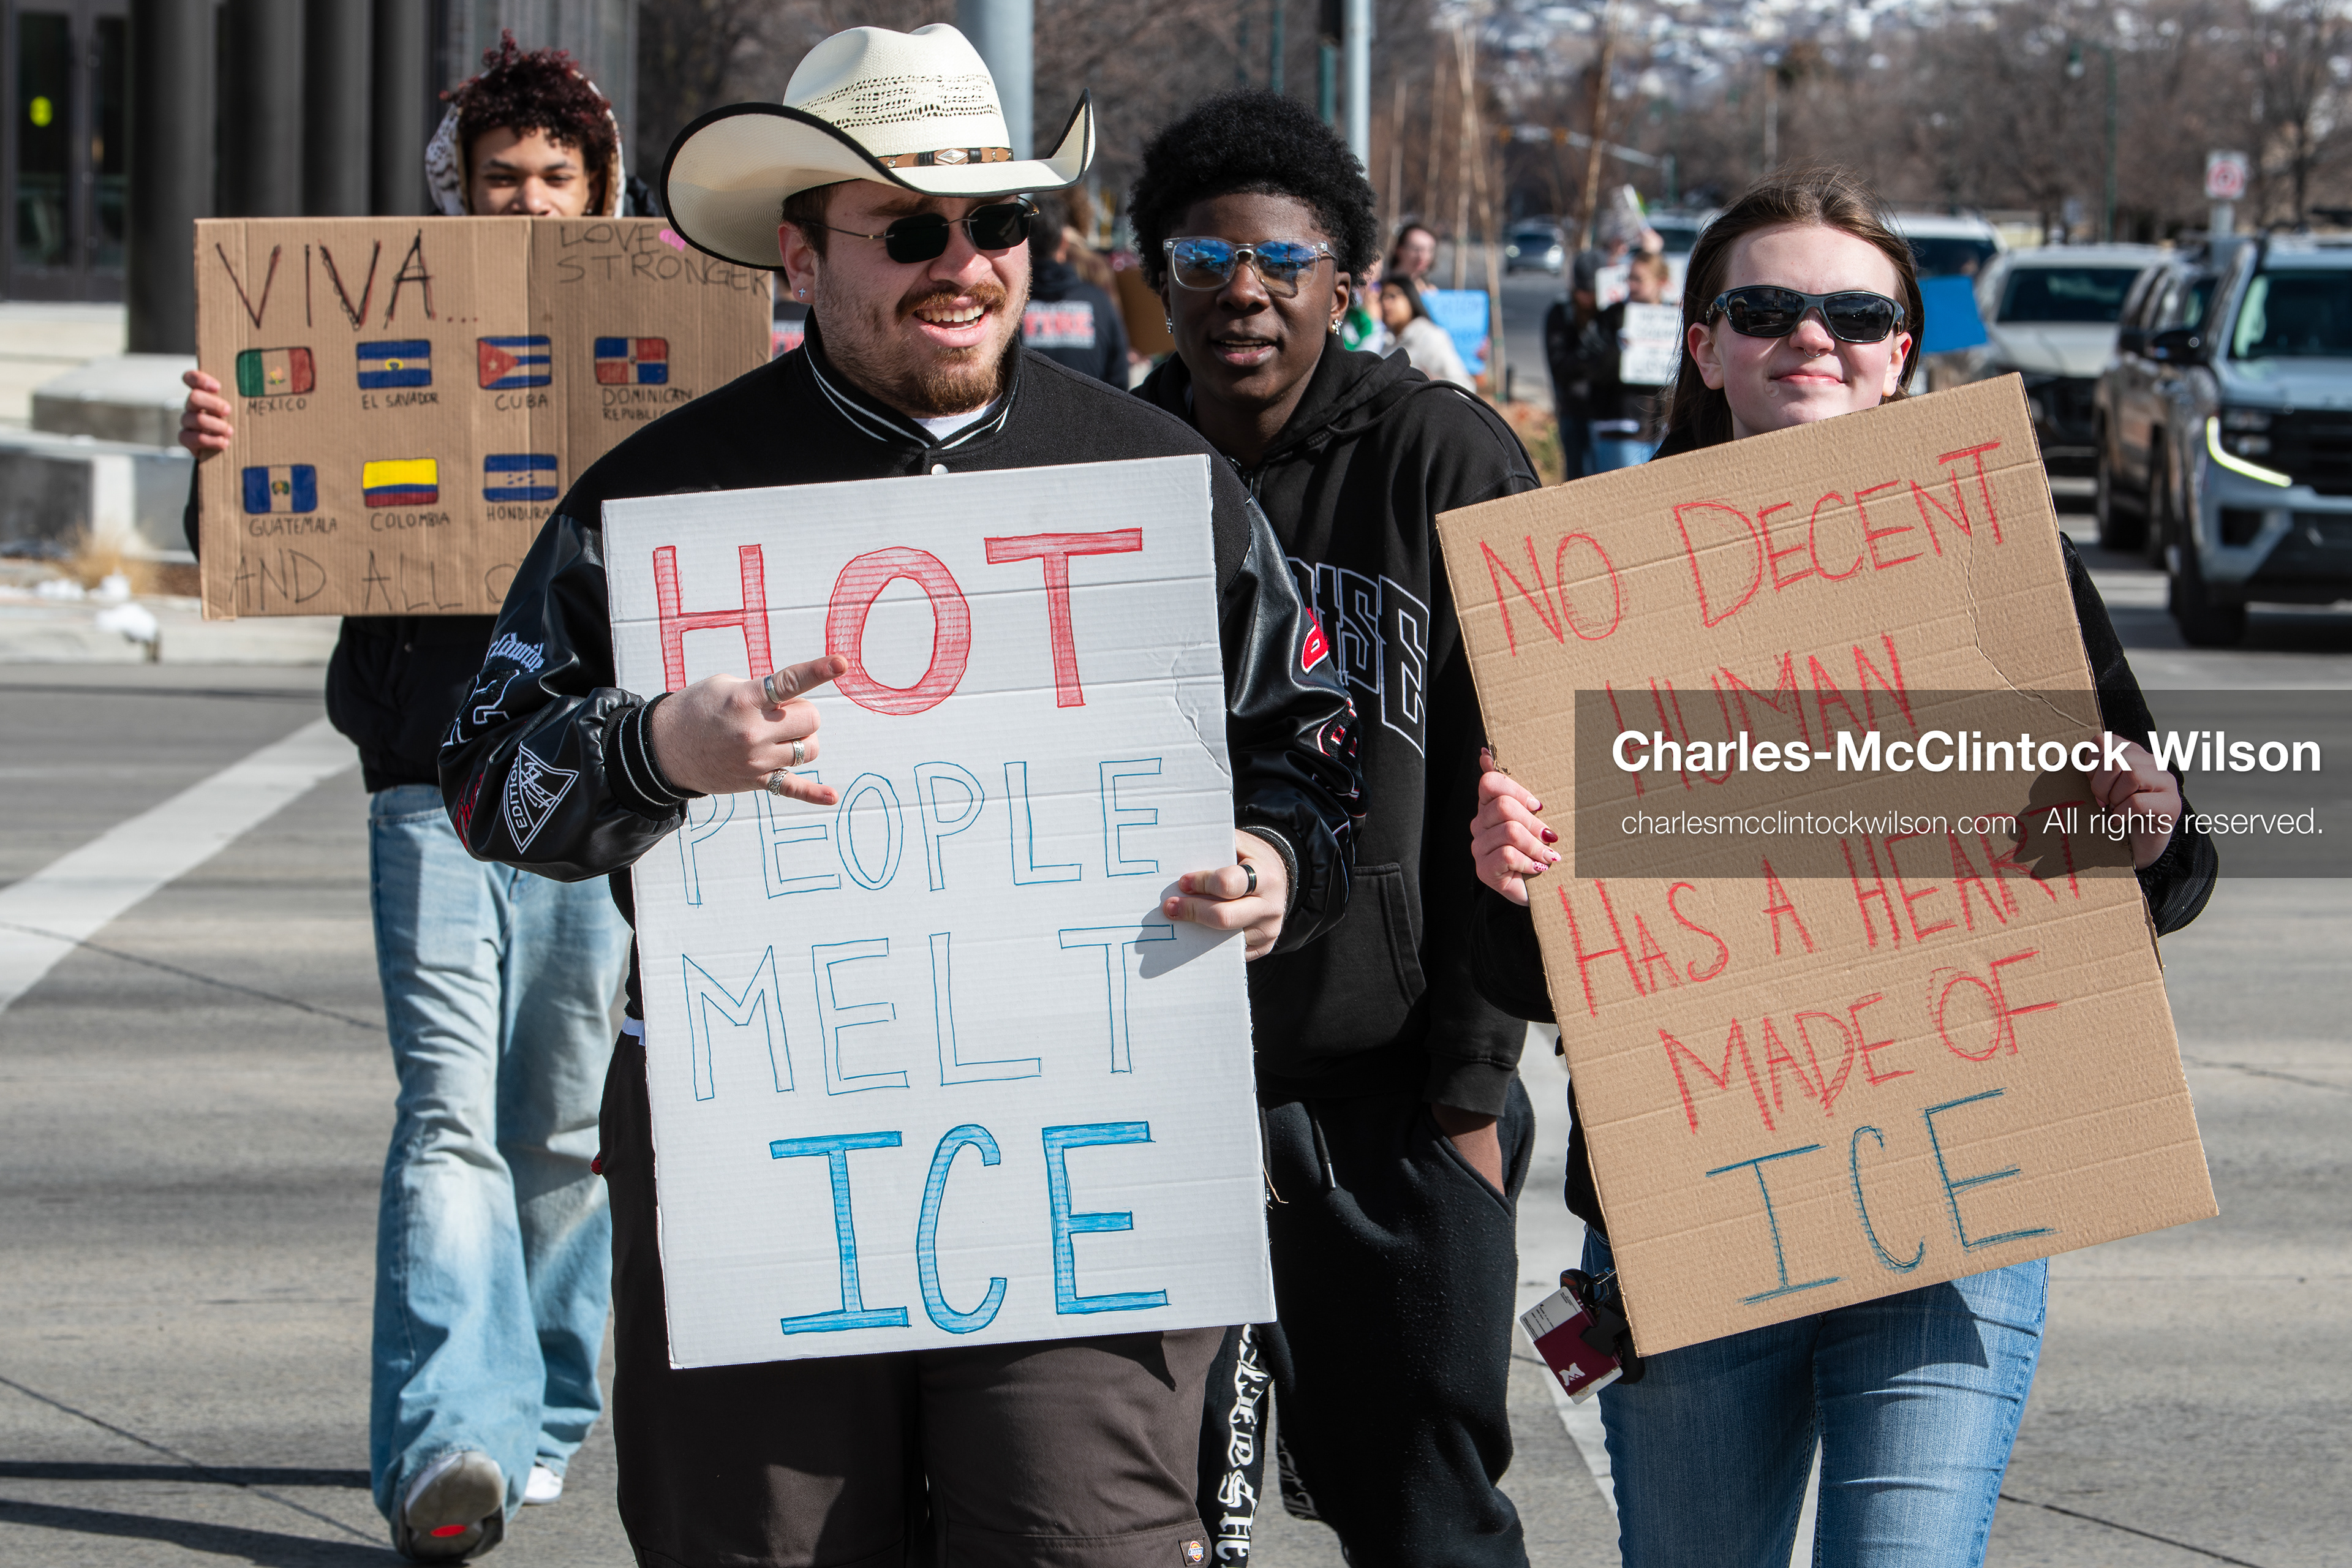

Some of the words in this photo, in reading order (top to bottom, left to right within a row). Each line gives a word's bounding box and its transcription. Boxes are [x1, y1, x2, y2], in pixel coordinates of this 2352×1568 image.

[560, 222, 660, 255] LOVE
[557, 252, 771, 300] STRONGER
[246, 398, 307, 416] MEXICO
[361, 394, 379, 410] EL
[495, 393, 548, 411] CUBA
[602, 387, 693, 407] DOMINICAN
[249, 517, 337, 537] GUATEMALA
[370, 511, 451, 532] COLOMBIA
[486, 505, 553, 522] HONDURA
[1480, 532, 1629, 656] NO
[1674, 437, 2003, 628] DECENT
[228, 549, 326, 610] AND
[362, 549, 463, 611] ALL
[652, 527, 1143, 715] HOT
[1607, 634, 1918, 799] HUMAN
[509, 756, 528, 829] EDITION
[678, 757, 1163, 908] PEOPLE
[1558, 878, 1730, 1019] HAS
[1761, 854, 1823, 956] A
[1838, 799, 2086, 951] HEART
[682, 924, 1177, 1101] MELT
[1658, 992, 1916, 1134] MADE
[1927, 947, 2059, 1063] OF
[769, 1121, 1171, 1335] ICE
[1705, 1086, 2062, 1306] ICE
